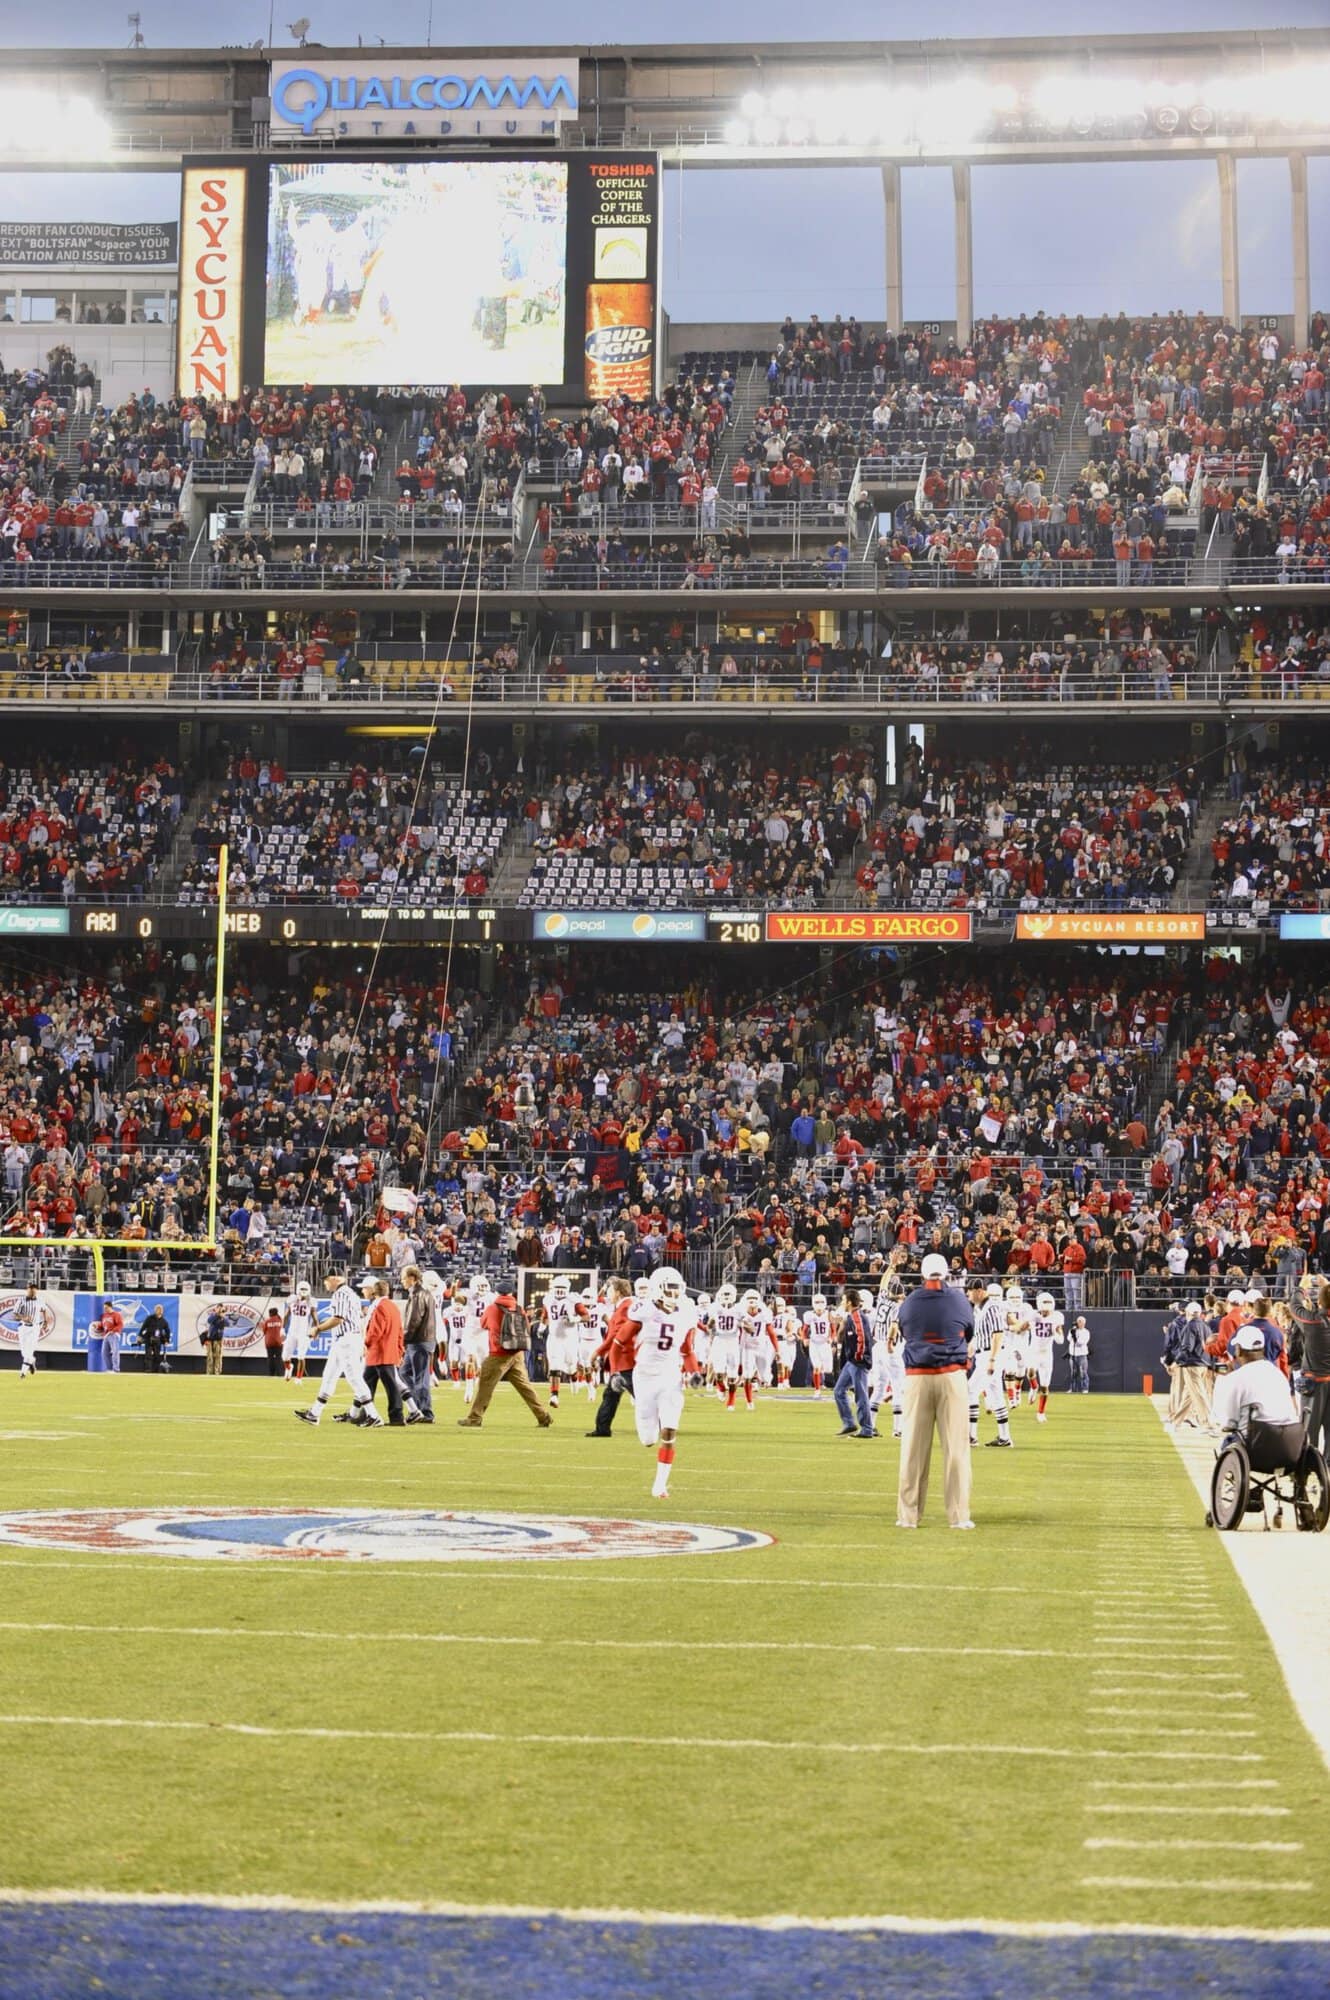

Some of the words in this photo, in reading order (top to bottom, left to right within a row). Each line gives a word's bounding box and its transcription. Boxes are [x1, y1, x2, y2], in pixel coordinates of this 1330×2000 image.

[273, 69, 577, 135] QUALCOMM
[338, 121, 555, 135] STADIUM
[590, 164, 655, 176] TOSHIBA
[596, 178, 648, 188] OFFICIAL
[601, 190, 643, 200] COPIER
[600, 202, 617, 213] OF
[618, 202, 643, 213] THE
[591, 214, 652, 225] CHARGERS
[1, 224, 41, 236] REPORT
[45, 225, 66, 236] FAN
[70, 225, 121, 237] CONDUCT
[1, 238, 22, 248] EXT
[139, 238, 170, 248] YOUR
[56, 250, 80, 261] AND
[82, 251, 115, 262] ISSUE
[118, 251, 133, 262] TO
[135, 250, 167, 261] 41513
[190, 180, 229, 393] SYCUAN
[1261, 318, 1277, 329] 19
[597, 328, 647, 343] BUD
[588, 339, 652, 356] LIGHT
[361, 909, 389, 919] DOWN
[397, 909, 410, 919] TO
[412, 909, 425, 919] GO
[433, 909, 456, 919] BALL
[456, 909, 470, 919] ON
[477, 909, 496, 920] QTR
[86, 912, 116, 931] ARI
[139, 918, 152, 937] 0
[224, 913, 261, 932] NEB
[283, 919, 296, 938] 0
[569, 918, 606, 933] pepsi
[657, 918, 694, 933] pepsi
[777, 918, 866, 936] WELLS
[871, 918, 959, 936] FARGO
[1059, 920, 1126, 933] SYCUAN
[1135, 920, 1198, 933] RESORT
[484, 920, 491, 939] 1
[551, 1304, 569, 1320] 54
[657, 1323, 675, 1351] 5
[1035, 1322, 1053, 1338] 23
